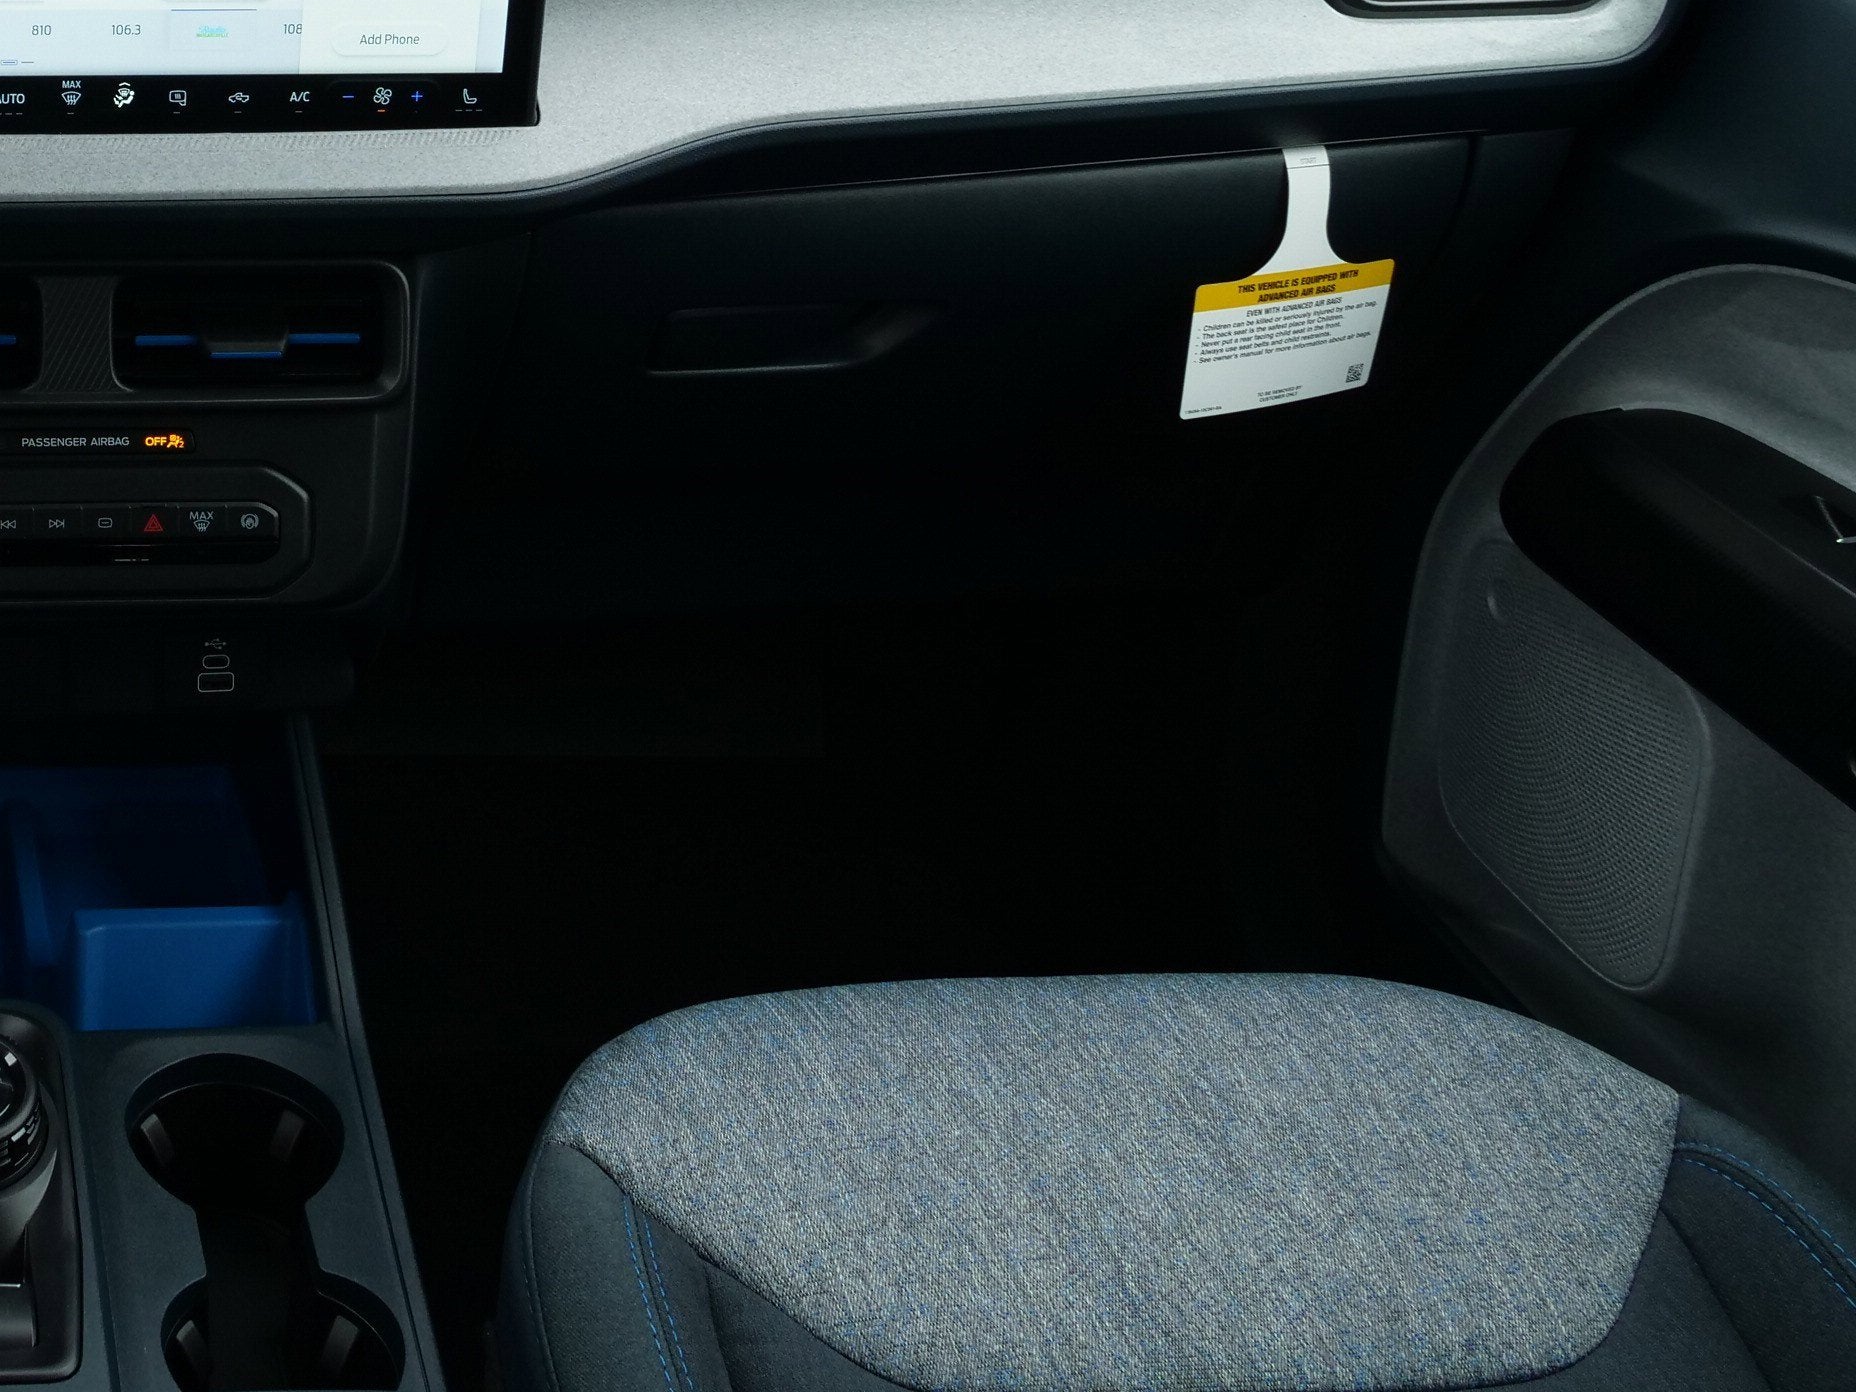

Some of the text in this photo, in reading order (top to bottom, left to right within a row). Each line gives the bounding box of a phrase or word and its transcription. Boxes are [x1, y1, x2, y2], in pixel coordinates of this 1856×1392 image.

[32, 25, 51, 36] 810
[111, 25, 141, 36] 106.3
[360, 34, 420, 45] Add Phone
[62, 81, 81, 89] MAX
[290, 91, 310, 102] A/C
[1238, 270, 1359, 293] THIS VEHICLE IS EQUIPPED WITH
[1258, 284, 1336, 303] ADVANCED AIR BAGS
[1247, 309, 1263, 317] EVEN
[1265, 306, 1280, 314] WITH
[1282, 301, 1314, 312] ADVANCED
[1326, 297, 1342, 305] BAGS
[22, 437, 166, 447] PASSENGER AIRBAG OFF
[190, 511, 214, 521] MAX
